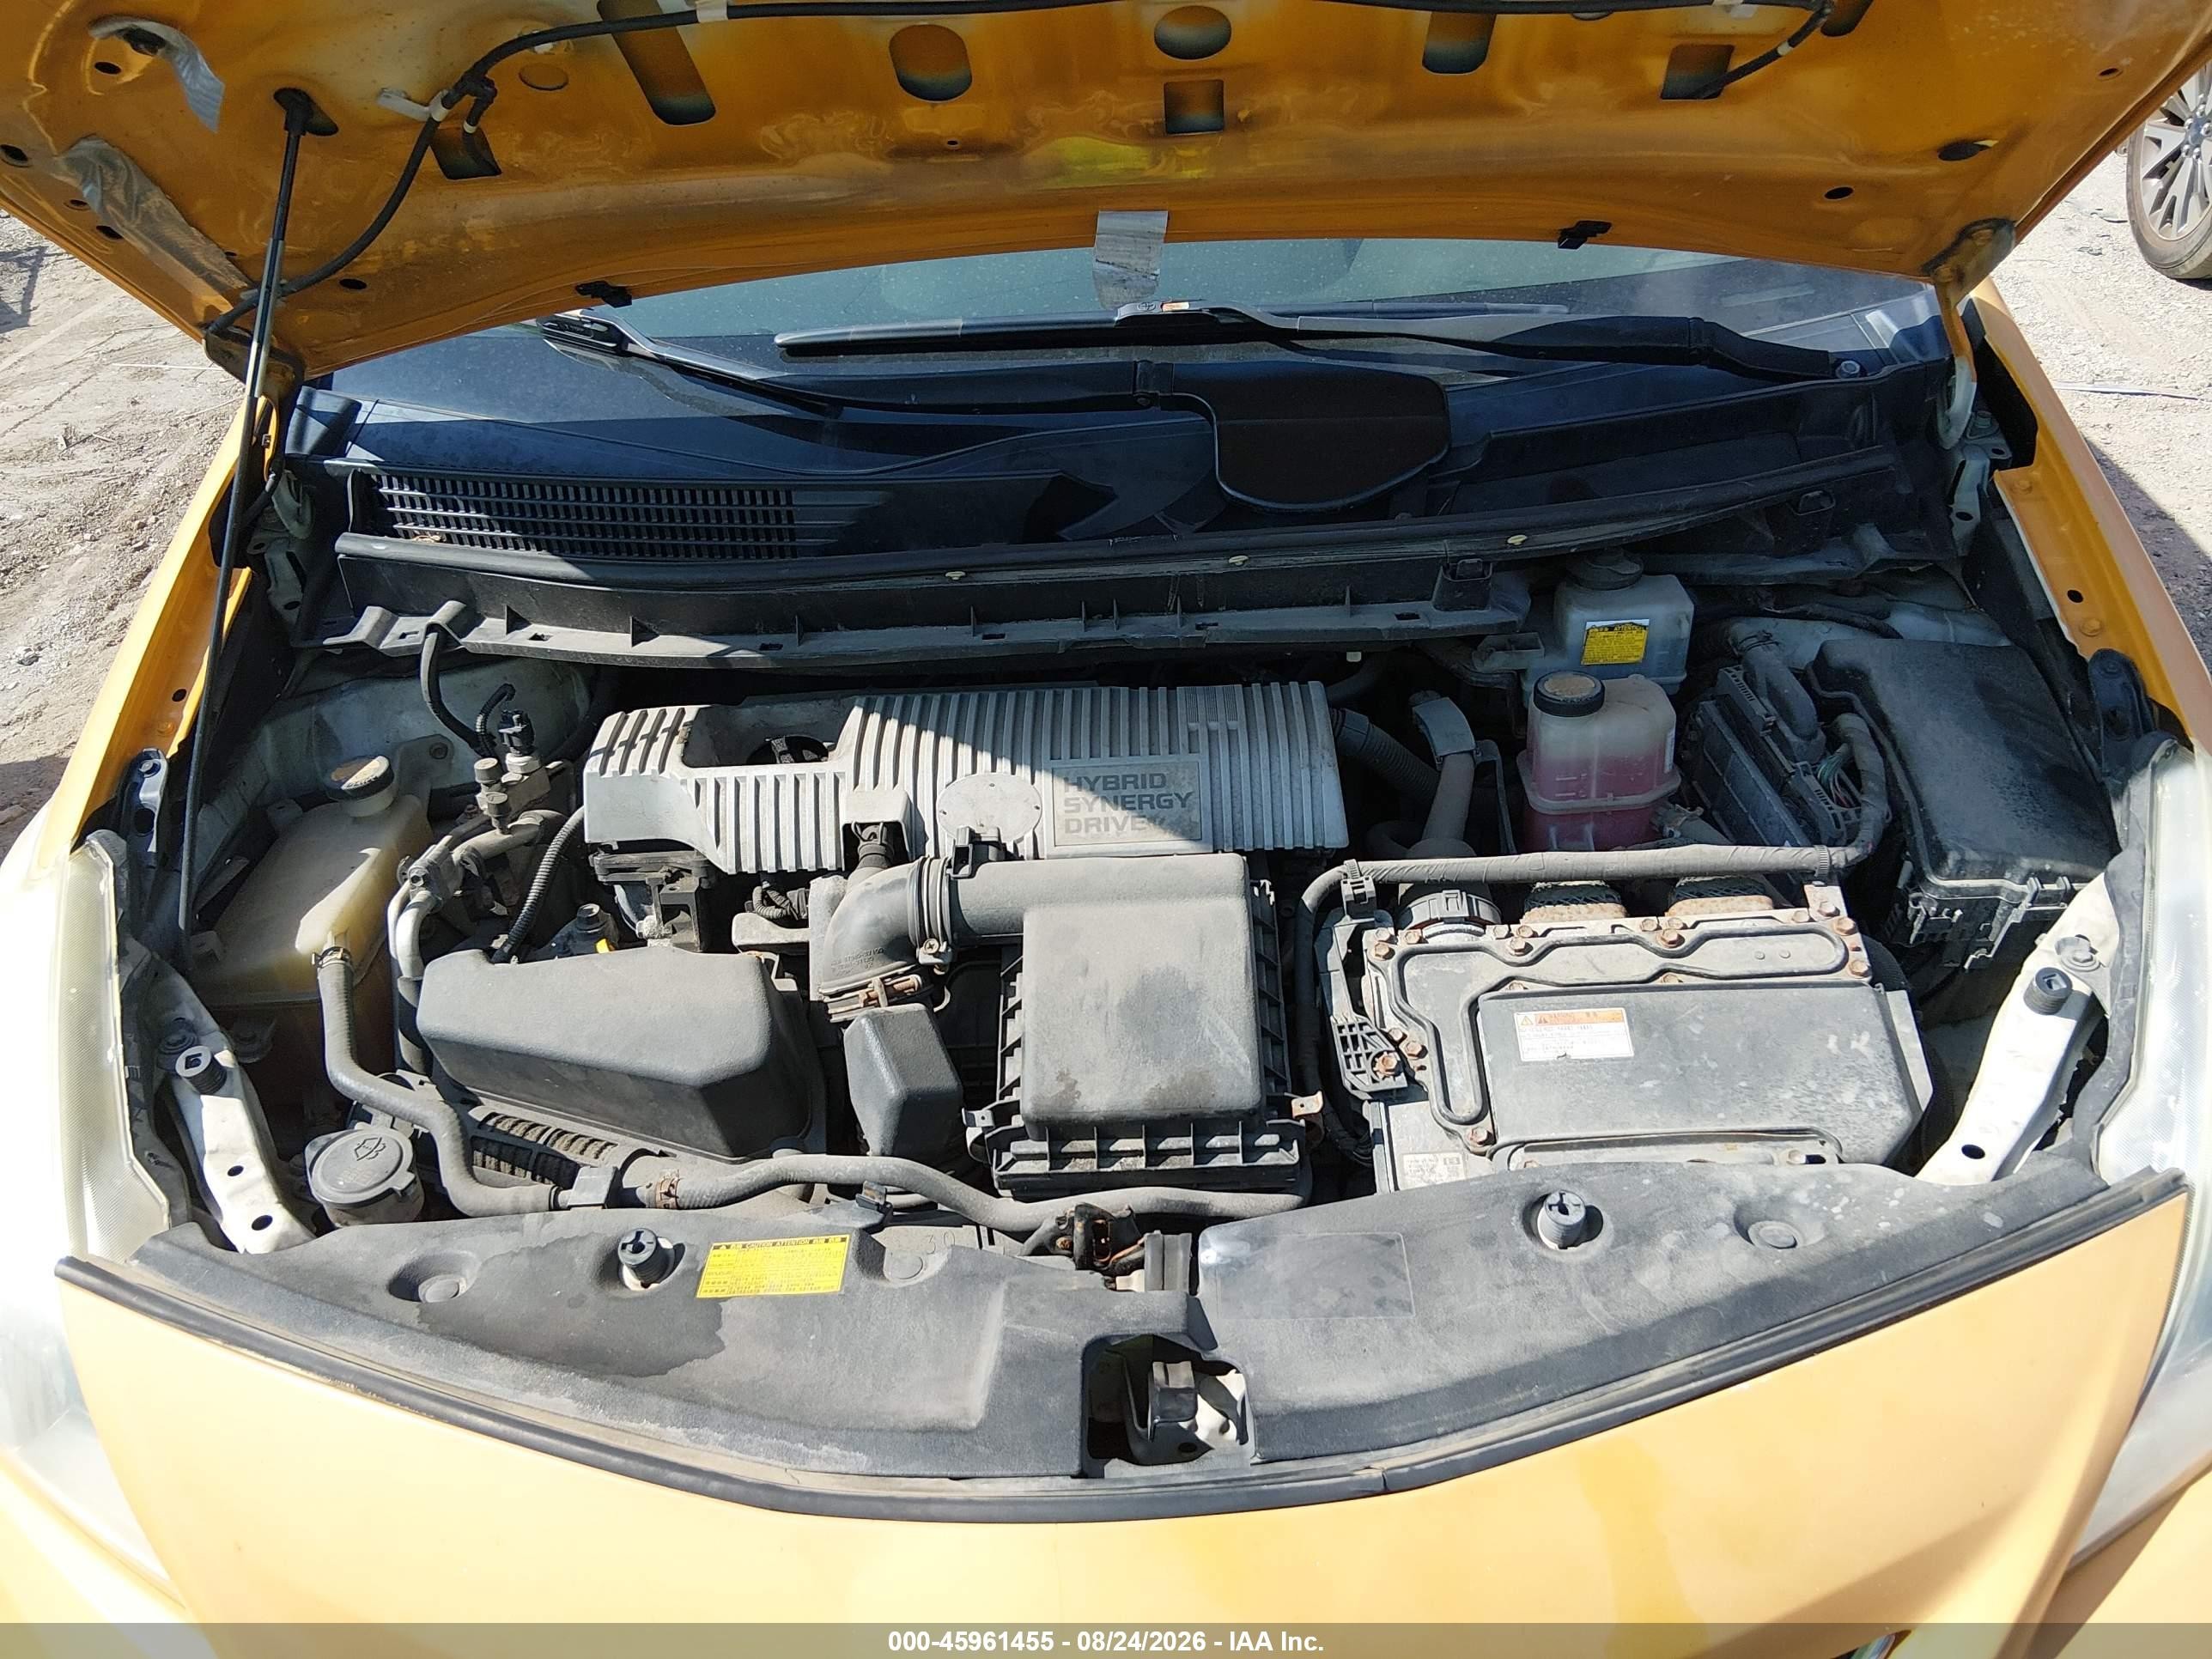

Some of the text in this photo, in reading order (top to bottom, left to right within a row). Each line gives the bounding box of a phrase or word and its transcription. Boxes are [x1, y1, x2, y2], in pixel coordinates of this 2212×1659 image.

[1064, 773, 1167, 792] HYBRID
[1064, 792, 1194, 813] SYNERGY
[1064, 815, 1148, 834] DRIVE
